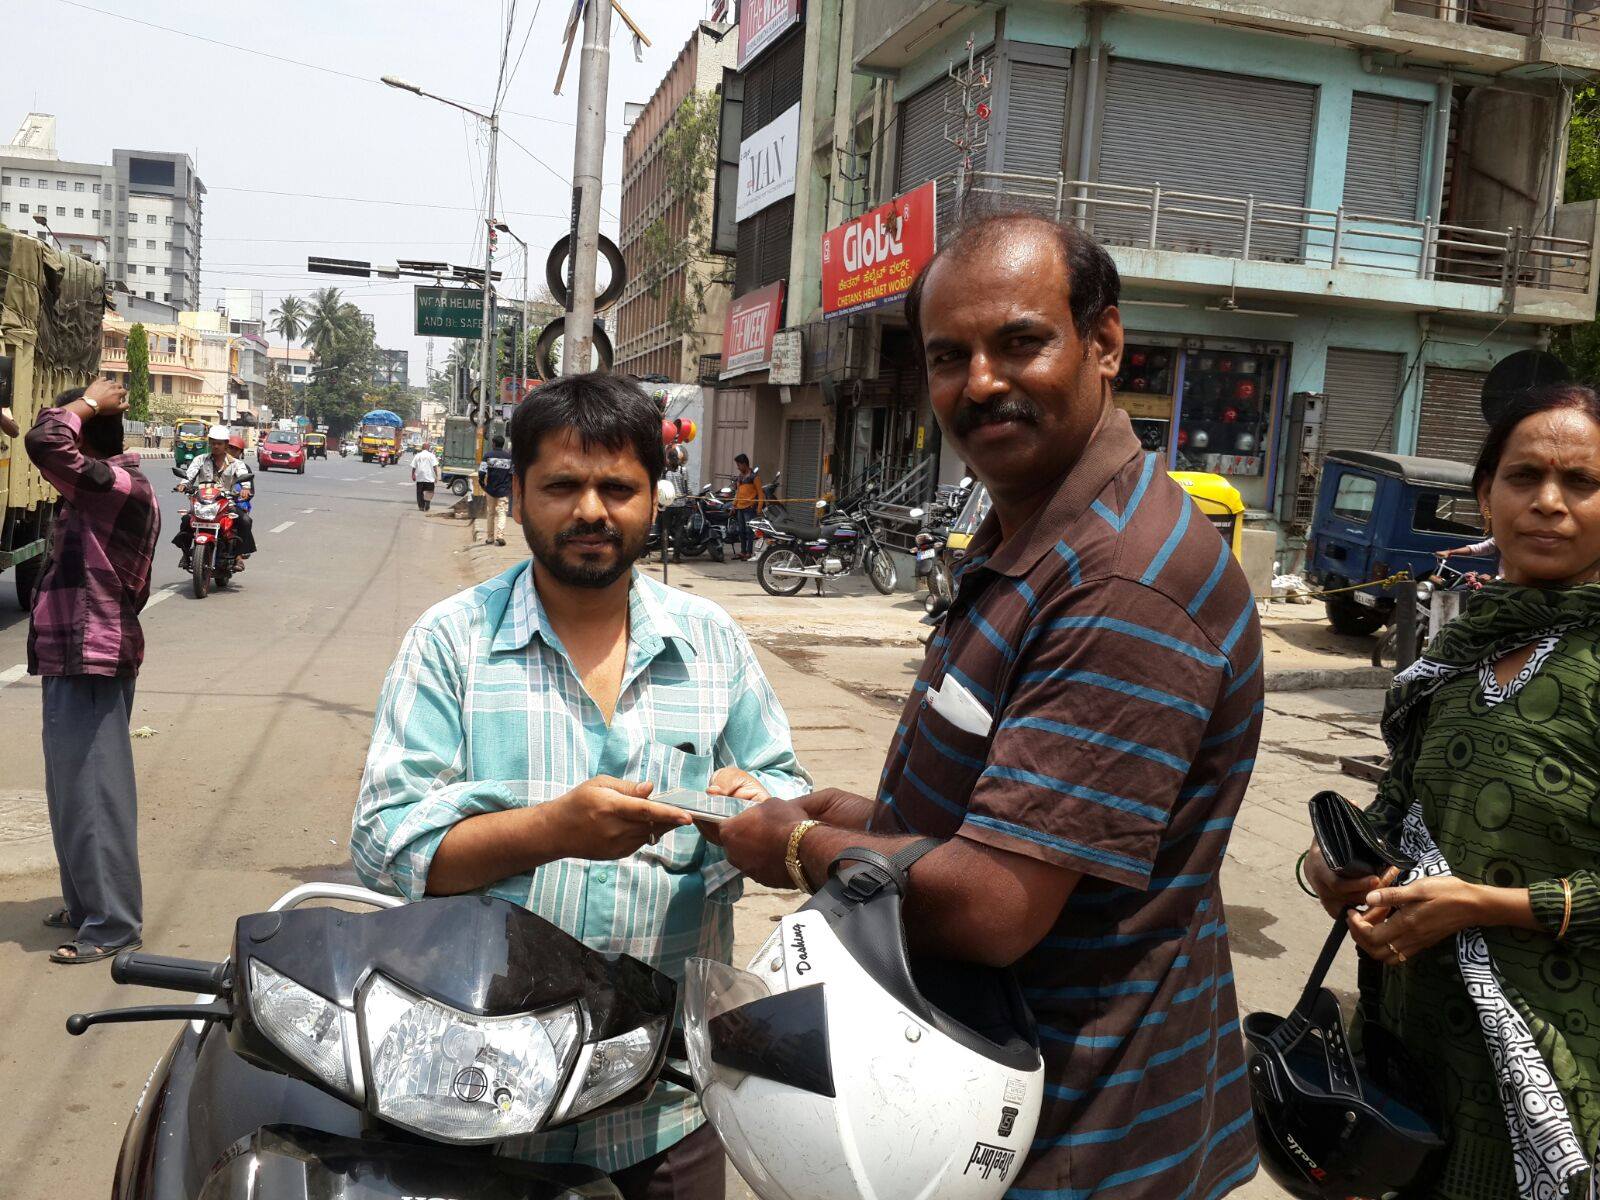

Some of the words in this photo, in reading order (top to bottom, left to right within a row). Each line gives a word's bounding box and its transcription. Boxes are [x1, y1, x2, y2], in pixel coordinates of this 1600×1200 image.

[763, 0, 788, 26] WE
[747, 135, 785, 197] MAN
[843, 213, 903, 273] Globe
[419, 296, 448, 308] WEAR
[863, 284, 887, 300] HELMET
[888, 276, 913, 292] WORLD
[423, 316, 443, 328] AND
[743, 306, 769, 351] WEEK
[792, 922, 812, 976] Dashing
[963, 1141, 1017, 1182] Steelbird
